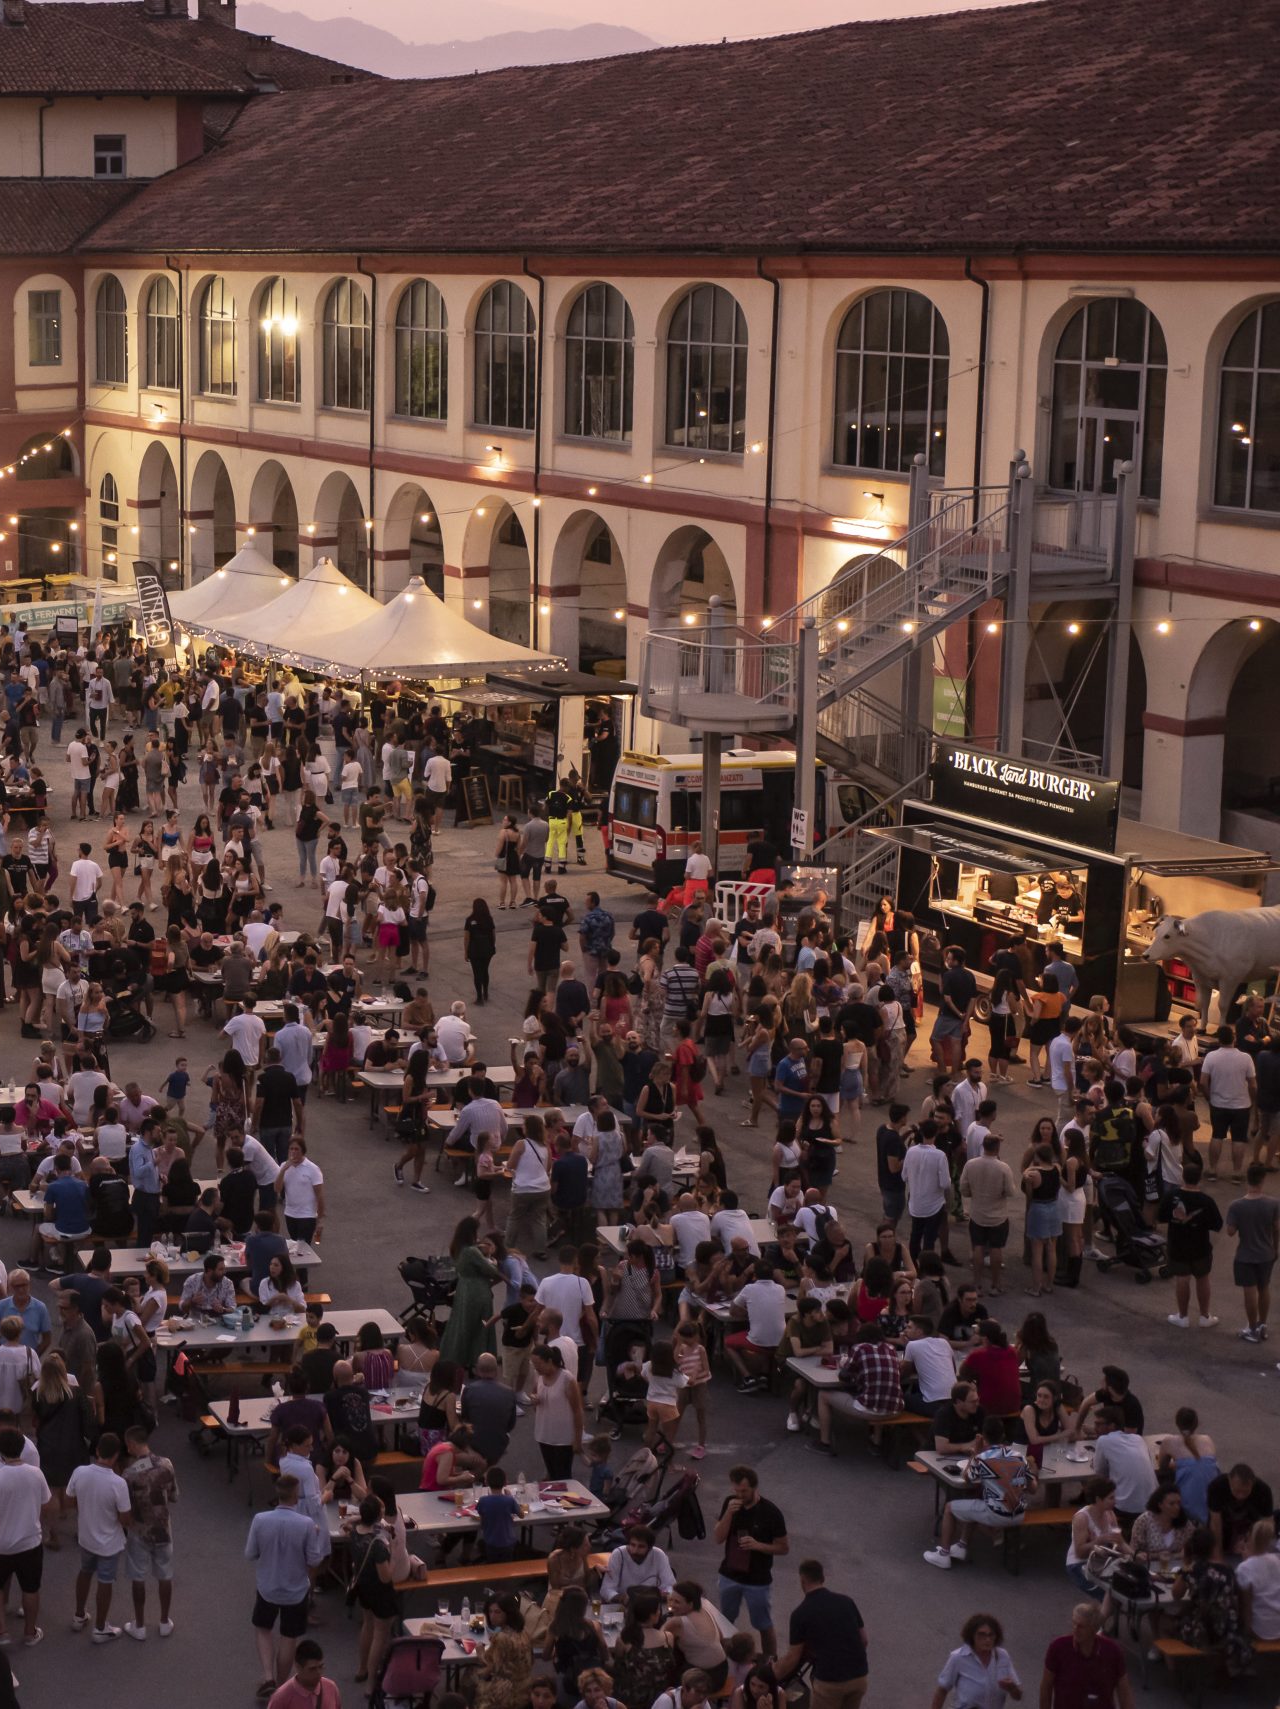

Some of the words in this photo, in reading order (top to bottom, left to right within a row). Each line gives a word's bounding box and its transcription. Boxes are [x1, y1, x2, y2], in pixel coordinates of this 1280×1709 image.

[35, 606, 84, 619] FERMENTO
[954, 751, 998, 779] BLACK
[999, 763, 1029, 786] Land
[1029, 769, 1091, 802] BURGER
[963, 780, 988, 793] HAMBURGER
[794, 811, 806, 822] WC
